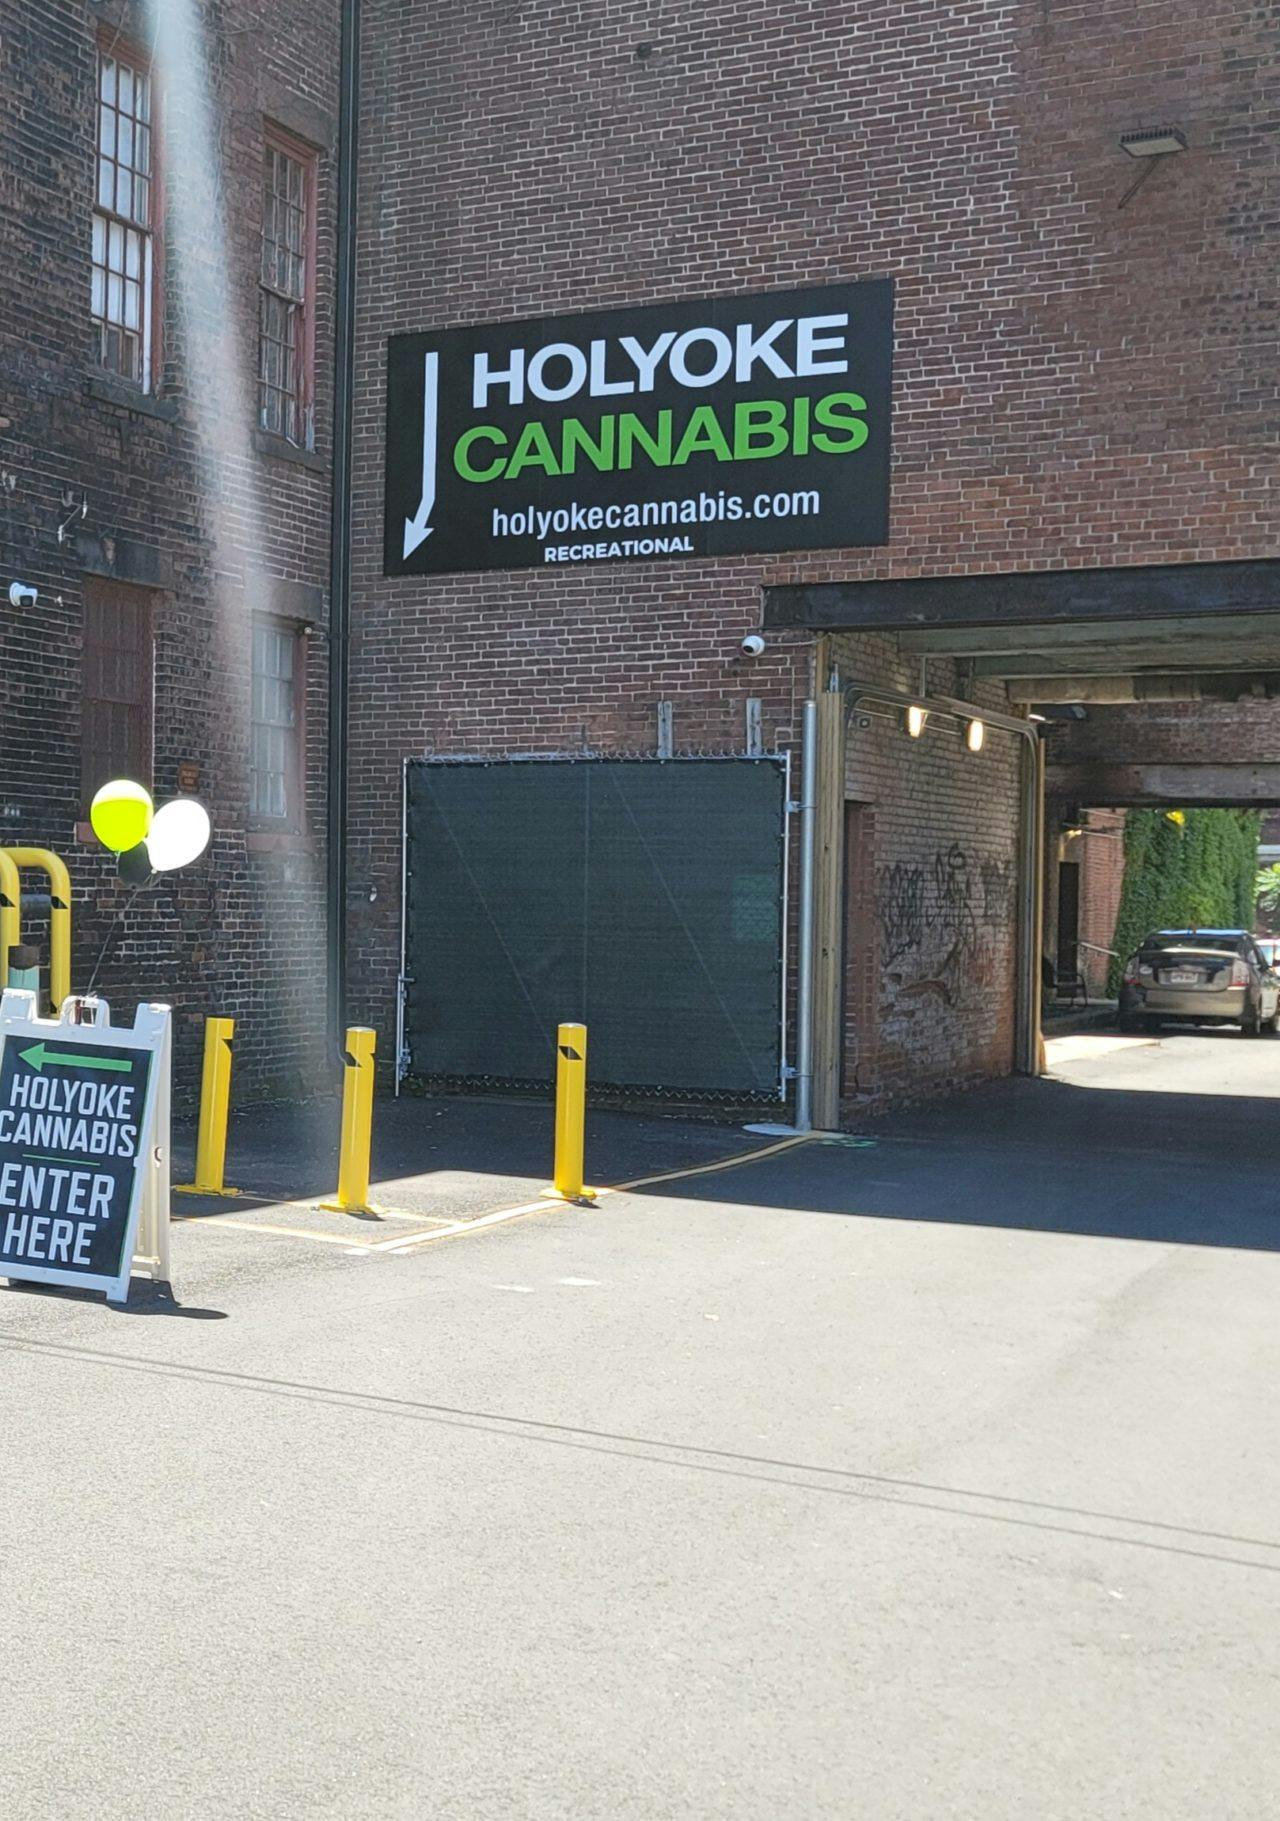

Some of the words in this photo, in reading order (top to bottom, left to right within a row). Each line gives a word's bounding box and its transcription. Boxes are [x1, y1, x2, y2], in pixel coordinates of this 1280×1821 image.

[472, 313, 849, 409] HOLYOKE
[453, 392, 870, 484] CANNABIS
[492, 490, 820, 540] holyokecannabis.com
[544, 536, 695, 563] RECREATIONAL
[9, 1074, 135, 1120] HOLYOKE
[2, 1212, 97, 1266] HERE
